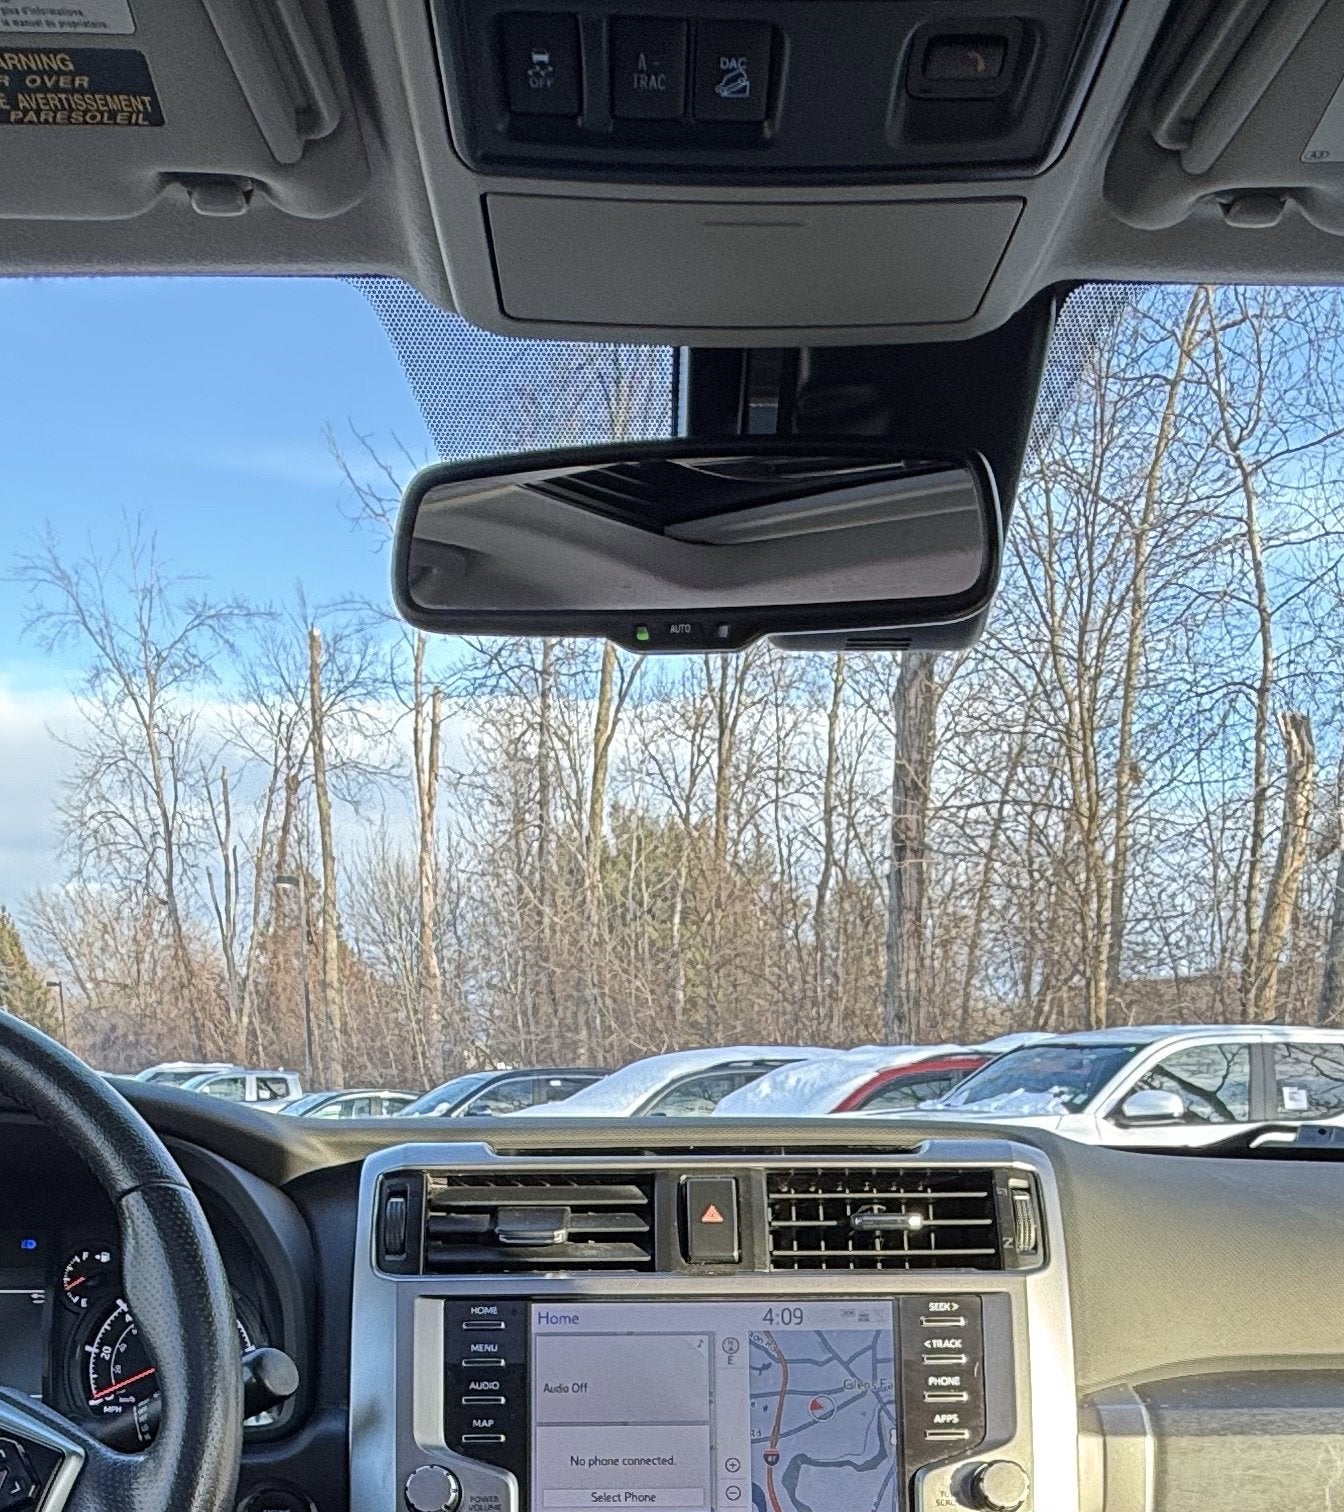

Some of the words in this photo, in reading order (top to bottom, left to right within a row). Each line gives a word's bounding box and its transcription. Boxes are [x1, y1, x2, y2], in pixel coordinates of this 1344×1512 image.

[720, 57, 748, 70] DAC
[25, 75, 90, 88] OVER
[632, 73, 666, 90] TRAC
[17, 93, 152, 113] AVERTISSEMENT
[10, 111, 150, 125] PARESOLEIL
[670, 623, 691, 634] AUTO
[471, 1306, 498, 1315] HOME
[537, 1311, 580, 1325] Home
[763, 1307, 804, 1326] 4:09
[470, 1344, 498, 1352] MENU
[931, 1339, 963, 1349] TRACK
[100, 1346, 112, 1361] 20
[727, 1355, 734, 1365] E
[469, 1381, 500, 1390] AUDIO
[928, 1376, 961, 1386] PHONE
[543, 1383, 570, 1393] Audio
[571, 1382, 588, 1393] Off
[103, 1405, 122, 1414] MPH
[472, 1419, 494, 1428] MAP
[933, 1414, 960, 1424] APPS
[570, 1455, 586, 1467] No
[588, 1455, 620, 1468] phone
[469, 1495, 500, 1503] POWER
[591, 1491, 622, 1503] Select
[624, 1491, 657, 1503] Phone
